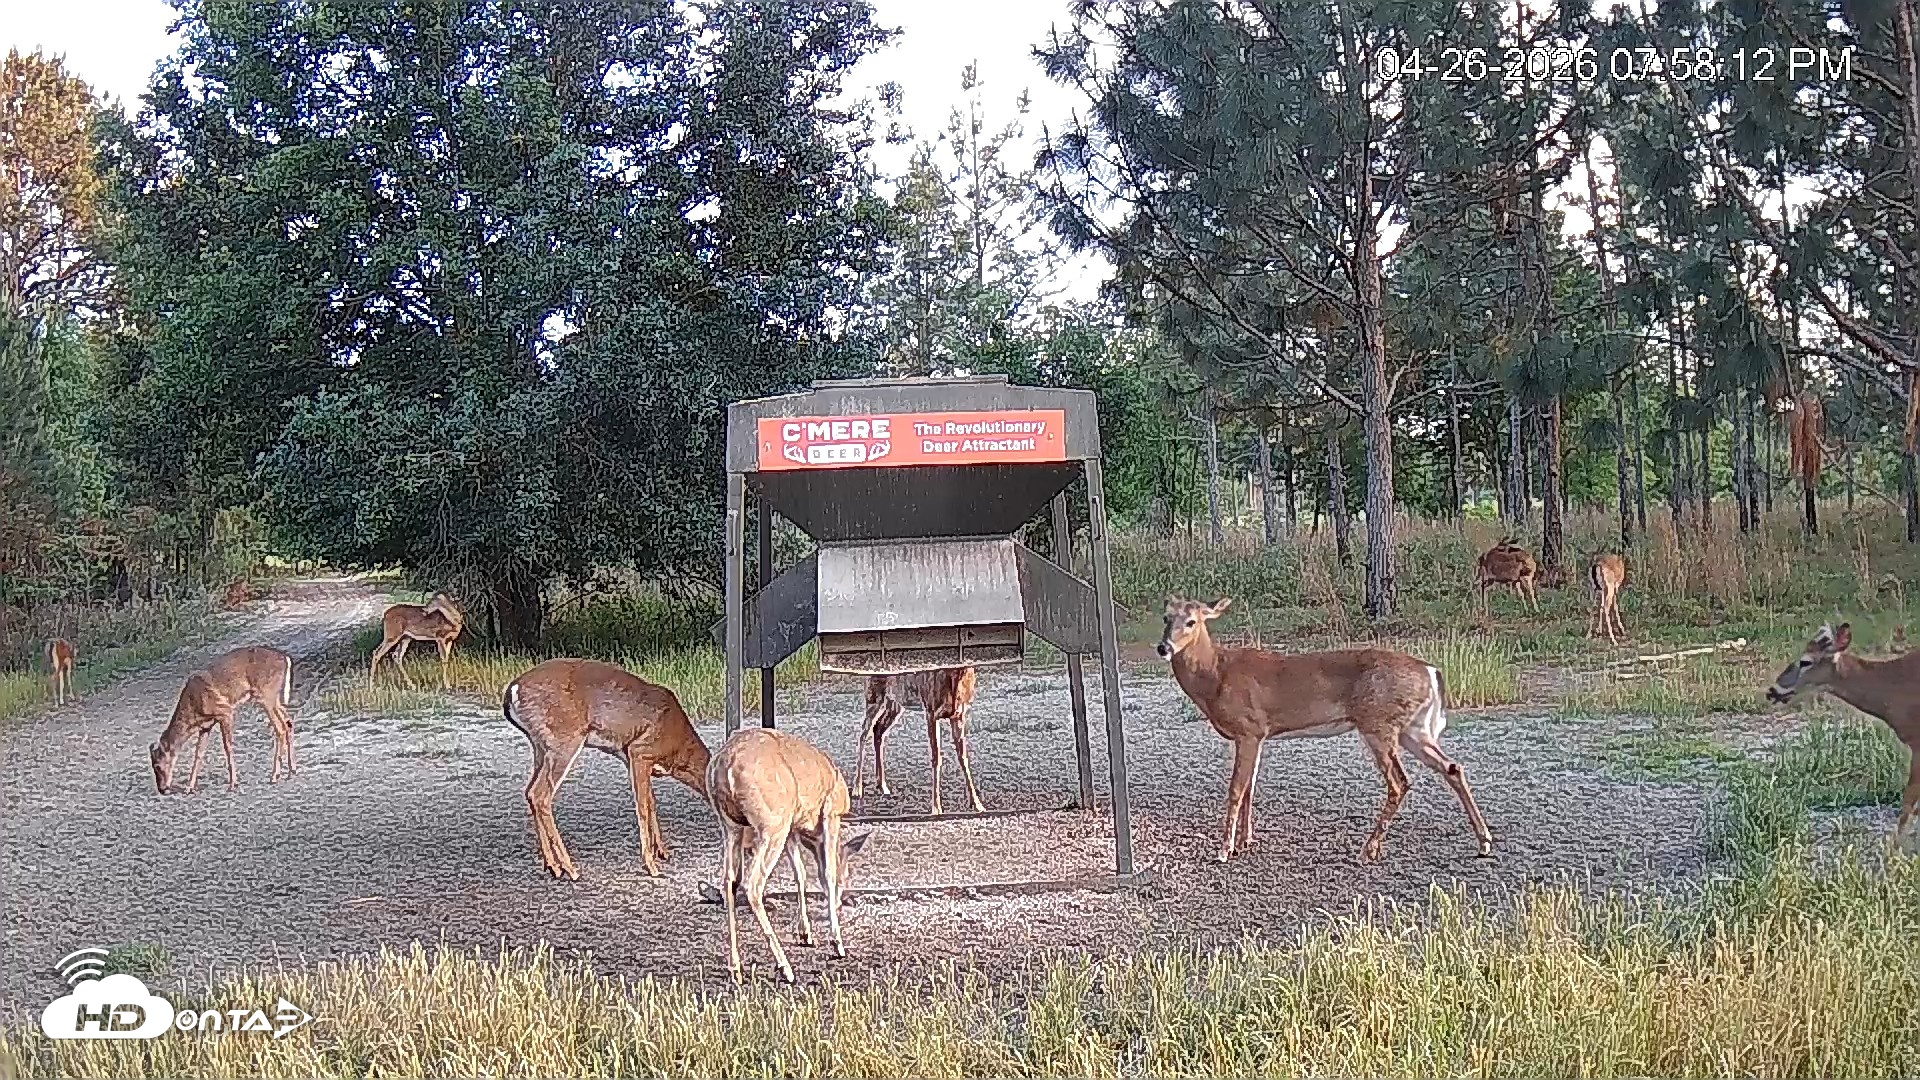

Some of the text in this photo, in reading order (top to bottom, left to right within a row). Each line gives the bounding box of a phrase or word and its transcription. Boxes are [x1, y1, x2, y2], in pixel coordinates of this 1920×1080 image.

[782, 419, 891, 442] C'MERE
[914, 420, 1046, 436] The Revolutionary
[922, 437, 1036, 453] Deer Attractant
[812, 448, 861, 460] DEER
